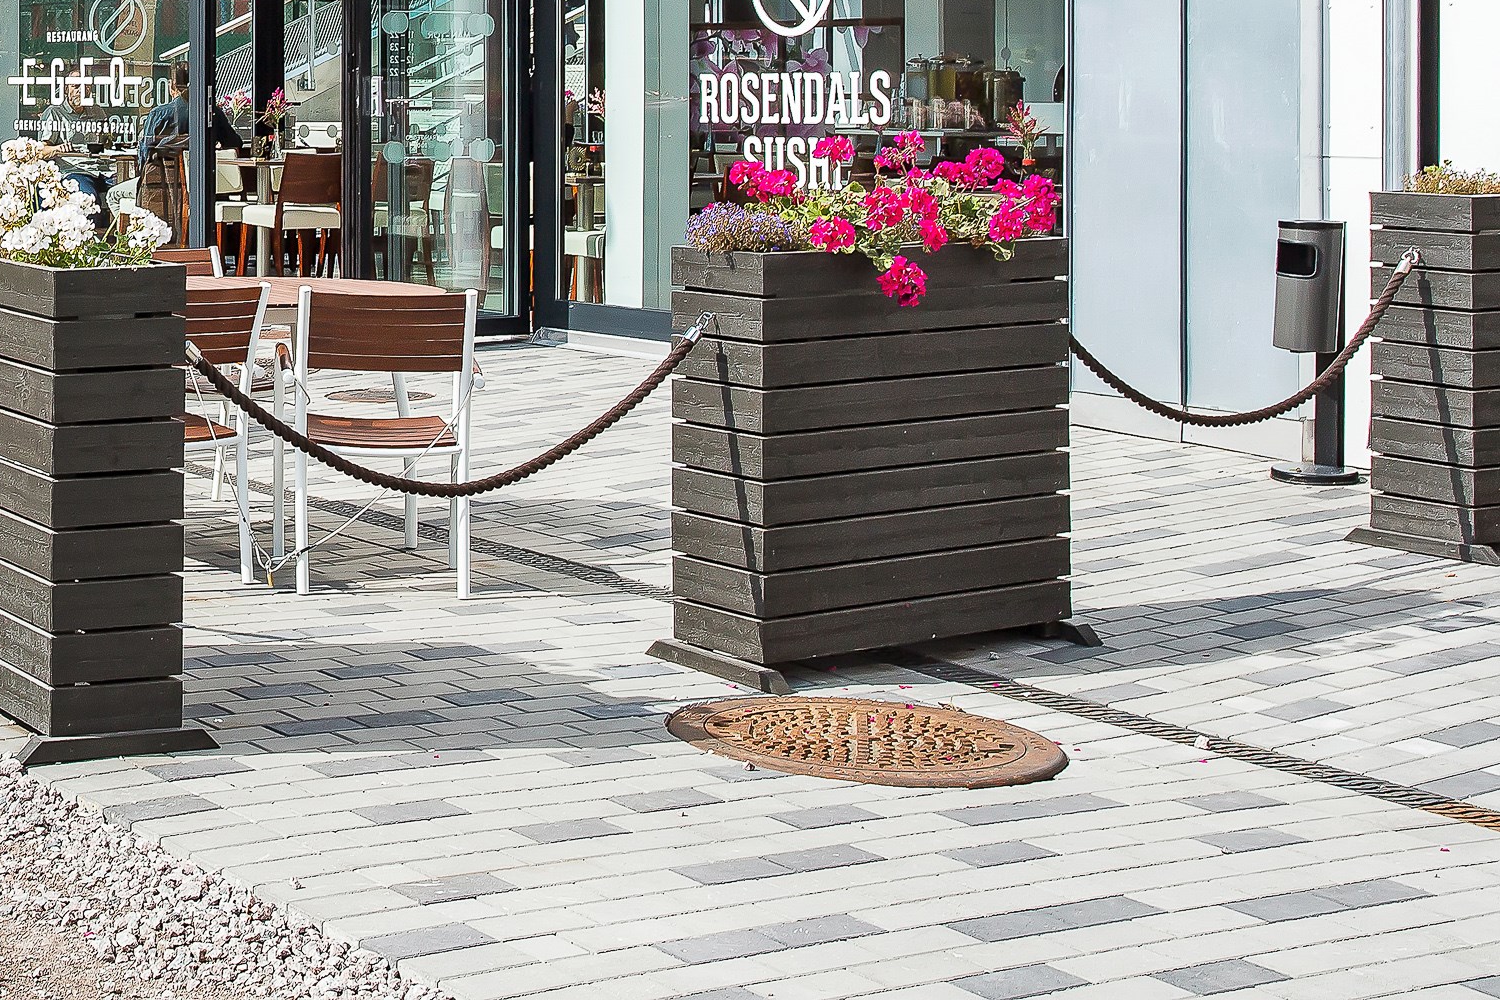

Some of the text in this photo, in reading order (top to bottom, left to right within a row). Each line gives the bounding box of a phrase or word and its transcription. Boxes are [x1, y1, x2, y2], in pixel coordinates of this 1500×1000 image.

[47, 30, 99, 43] RESTAURANG
[22, 56, 125, 107] EGEO
[700, 70, 891, 125] ROSENDALS
[76, 121, 102, 133] GYROS
[110, 122, 135, 134] PIZZA
